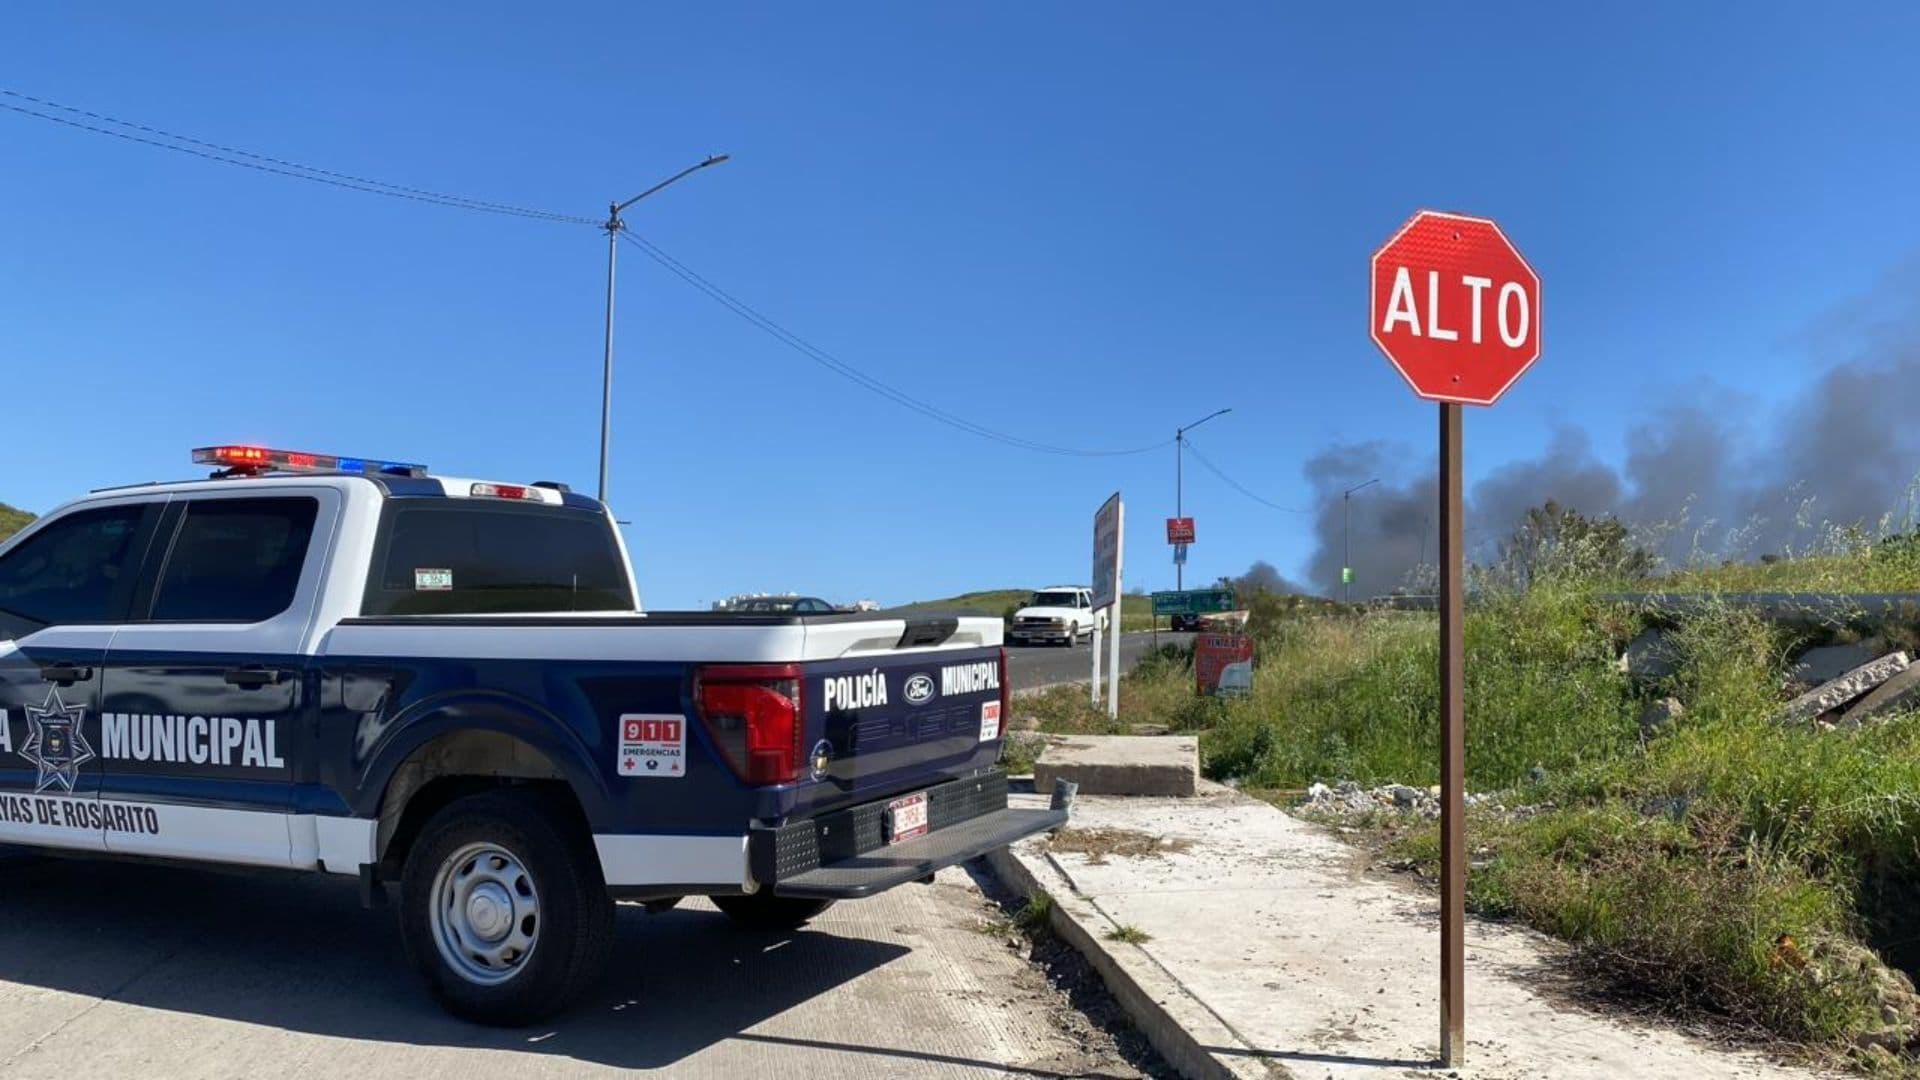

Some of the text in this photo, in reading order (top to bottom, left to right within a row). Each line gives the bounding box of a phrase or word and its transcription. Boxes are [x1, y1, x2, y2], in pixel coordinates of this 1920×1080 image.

[1383, 266, 1530, 348] ALTO
[824, 661, 1000, 712] POLICÍA MUNICIPAL
[909, 679, 930, 698] Ford
[101, 713, 285, 769] MUNICIPAL
[627, 722, 675, 740] 911
[623, 748, 681, 757] EMERGENCIAS
[0, 795, 160, 835] YAS DE ROSARITO
